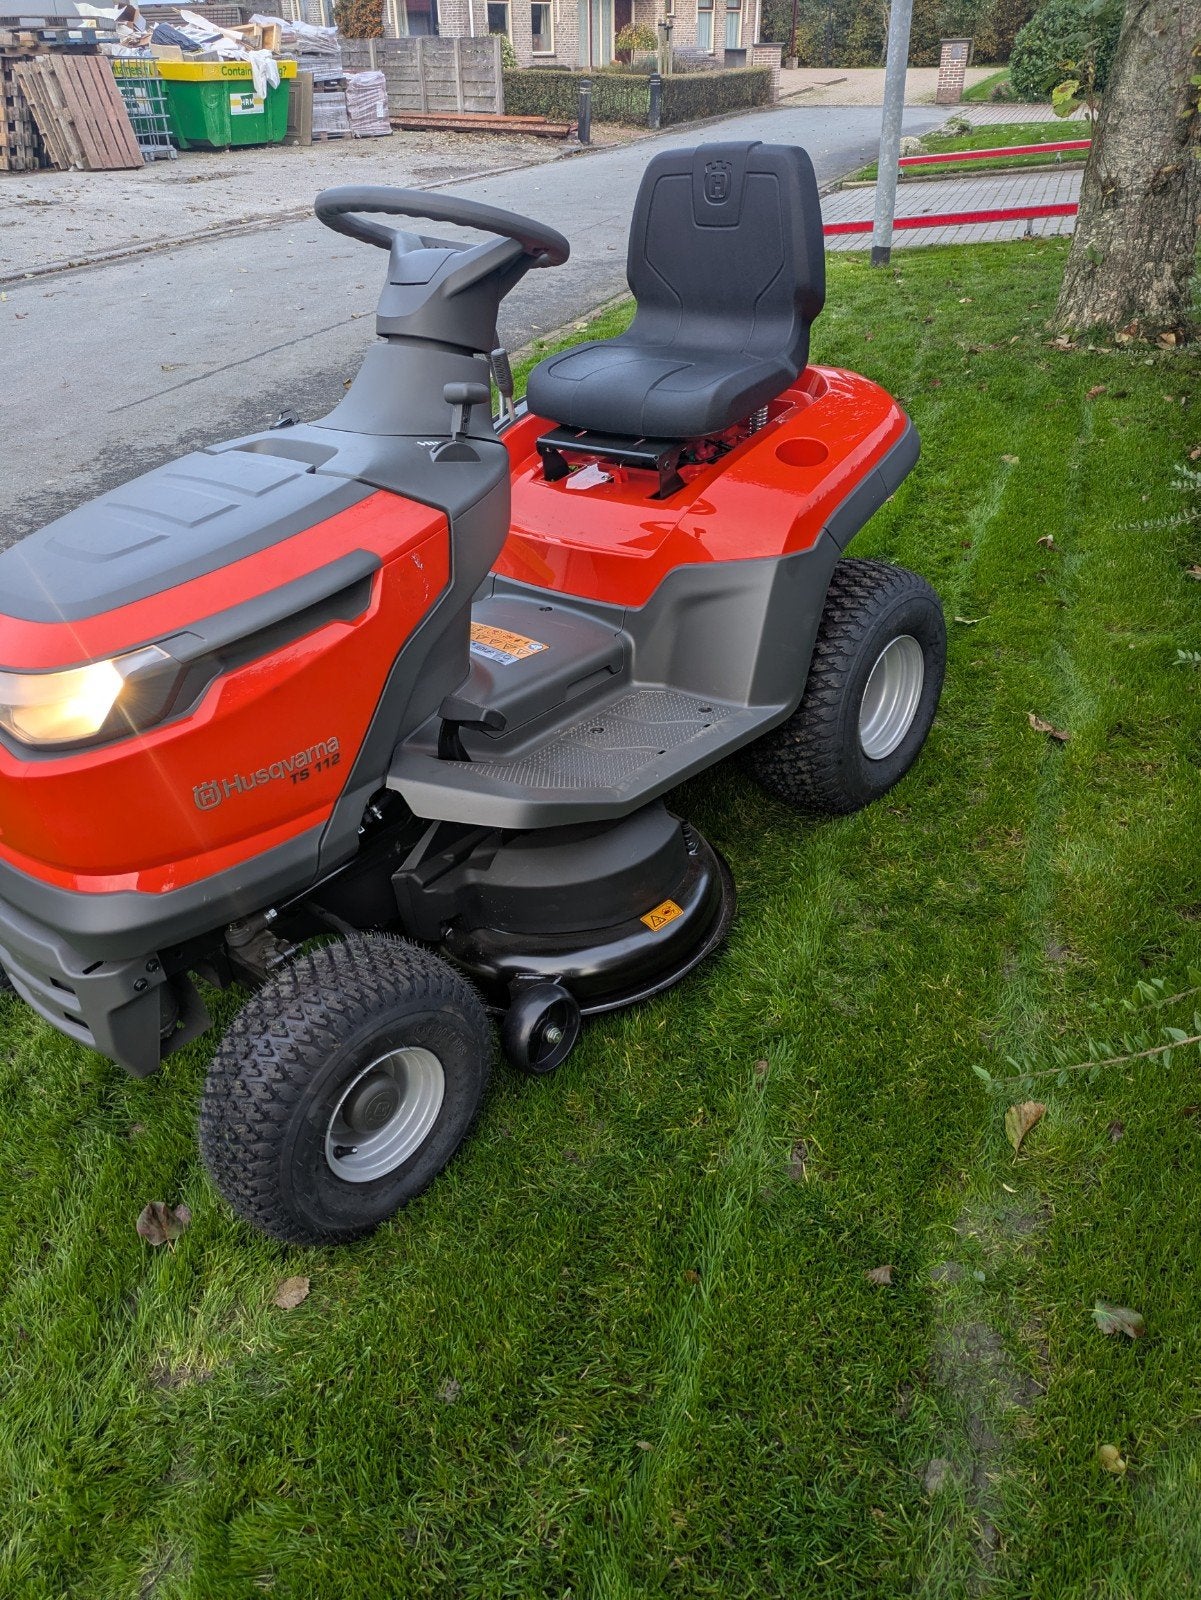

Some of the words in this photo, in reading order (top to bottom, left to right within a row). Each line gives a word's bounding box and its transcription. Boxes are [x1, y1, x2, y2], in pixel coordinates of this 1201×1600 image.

[221, 66, 253, 76] Contain
[221, 736, 340, 798] Husqvarna
[290, 768, 310, 785] TS
[314, 753, 340, 772] 112
